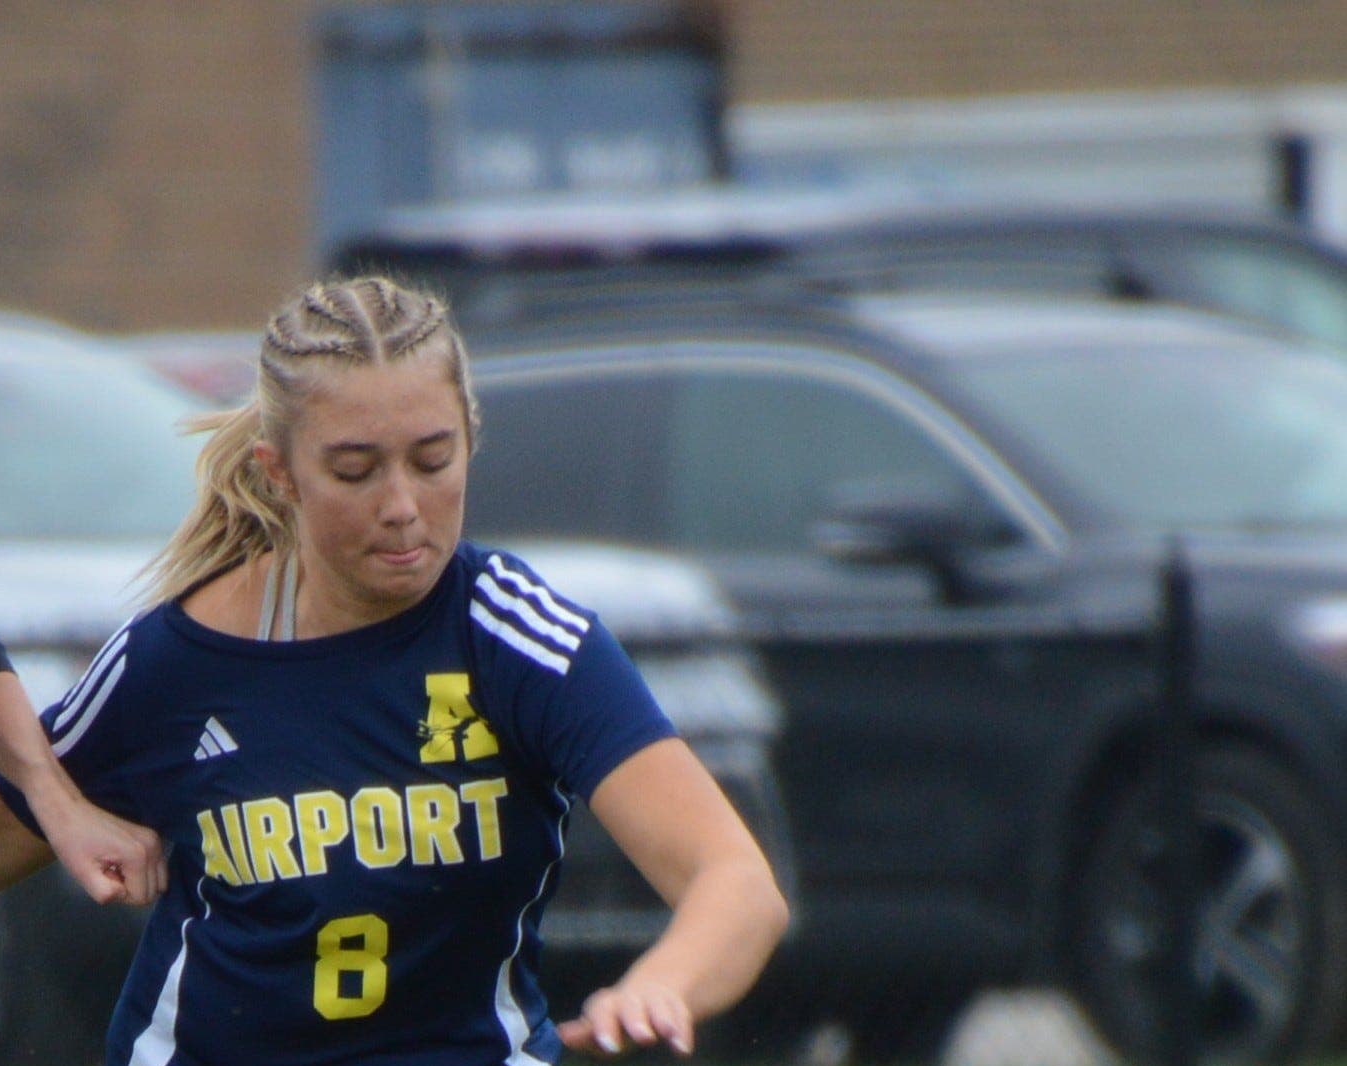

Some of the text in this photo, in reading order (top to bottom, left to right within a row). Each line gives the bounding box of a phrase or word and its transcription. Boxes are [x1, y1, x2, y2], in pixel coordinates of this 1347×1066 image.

[417, 671, 500, 764] A
[196, 777, 509, 887] AIRPORT
[312, 913, 389, 1021] 8
